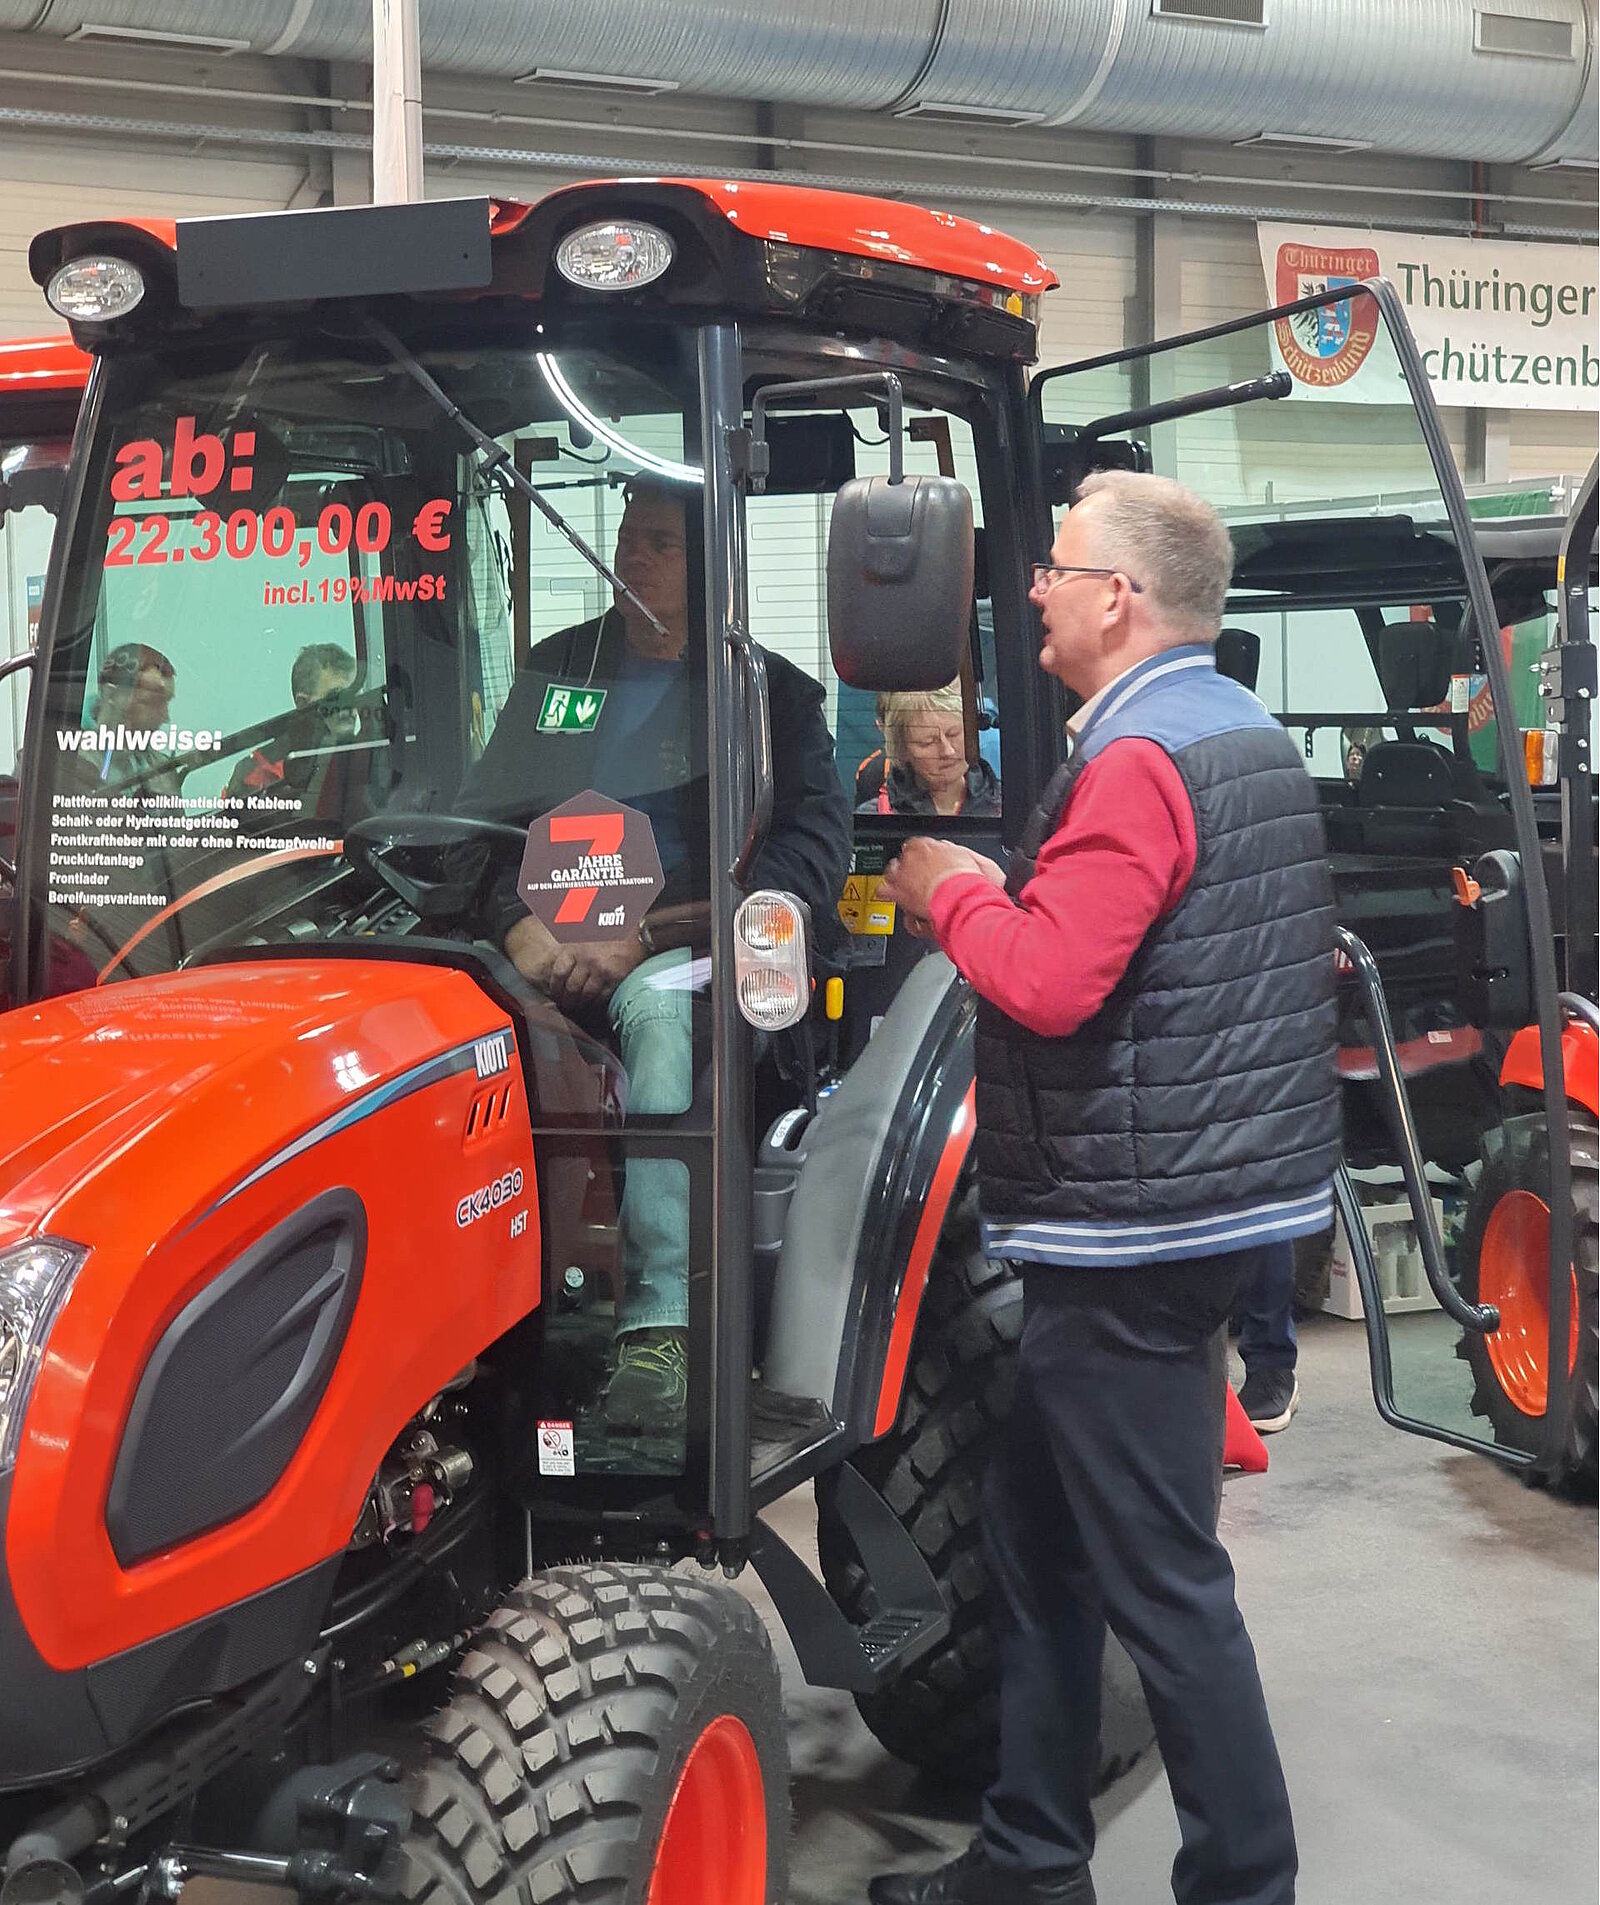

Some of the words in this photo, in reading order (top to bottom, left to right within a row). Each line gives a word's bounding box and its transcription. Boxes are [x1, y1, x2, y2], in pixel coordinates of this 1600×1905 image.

[1284, 247, 1374, 276] Thüringer
[1397, 262, 1596, 327] Thüringer
[1277, 322, 1371, 384] Schützenbund
[1398, 337, 1599, 387] chützenb
[110, 416, 256, 503] ab:
[103, 501, 392, 568] 22.300,00
[412, 498, 452, 551] €
[56, 724, 222, 751] wahlweise:
[52, 795, 108, 809] Plattform
[111, 796, 139, 809] oder
[141, 796, 244, 809] vollklimatisierte
[247, 796, 302, 810] Kabiene
[52, 814, 93, 828] Schalt-
[96, 815, 123, 828] oder
[126, 815, 239, 831] Hydrostatgetriebe
[50, 833, 144, 848] Frontkraftheber
[146, 834, 167, 848] mit
[170, 835, 199, 848] oder
[201, 835, 233, 849] ohne
[236, 835, 334, 851] Frontzapfwelle
[50, 853, 144, 869] Druckluftanlage
[549, 813, 624, 924] 7
[551, 867, 624, 882] GARANTIE
[578, 854, 622, 870] JAHRE
[49, 872, 109, 885] Frontlader
[527, 883, 539, 891] AUF
[540, 882, 553, 891] DEN
[605, 879, 619, 888] VON
[619, 876, 654, 886] TRAKTOREN
[49, 890, 167, 907] Bereifungsvarianten
[475, 1035, 508, 1078] KIOTI
[456, 1168, 524, 1228] CK4030
[510, 1209, 529, 1239] HST
